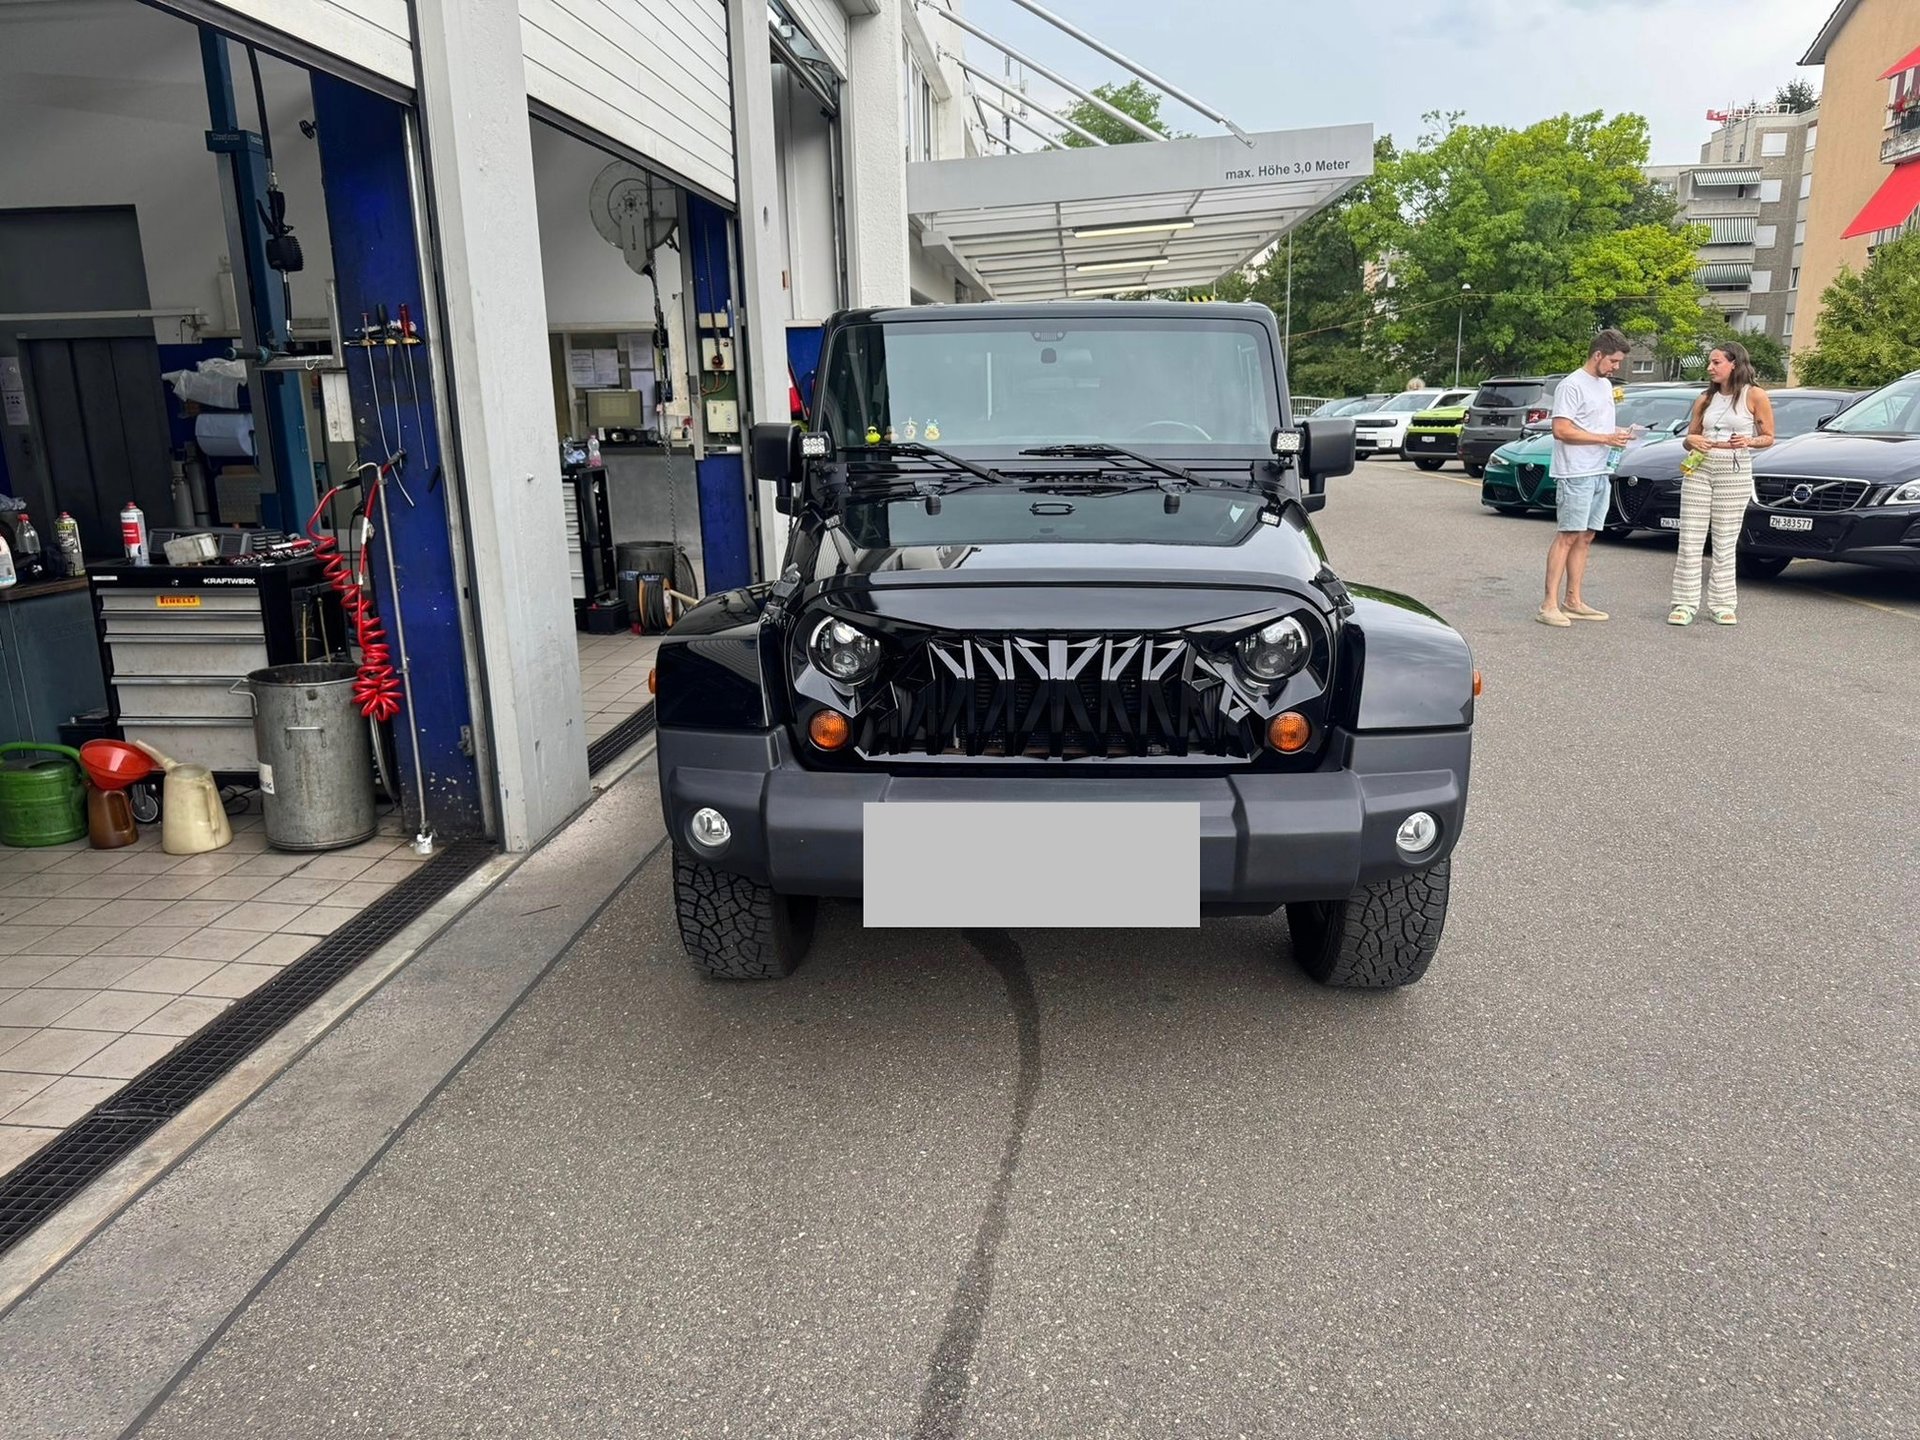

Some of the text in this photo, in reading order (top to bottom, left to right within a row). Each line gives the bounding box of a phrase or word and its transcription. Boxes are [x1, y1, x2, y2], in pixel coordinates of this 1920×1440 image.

[1226, 159, 1351, 180] max. Höhe 3,0 Meter
[203, 577, 256, 585] KRAFTWERK
